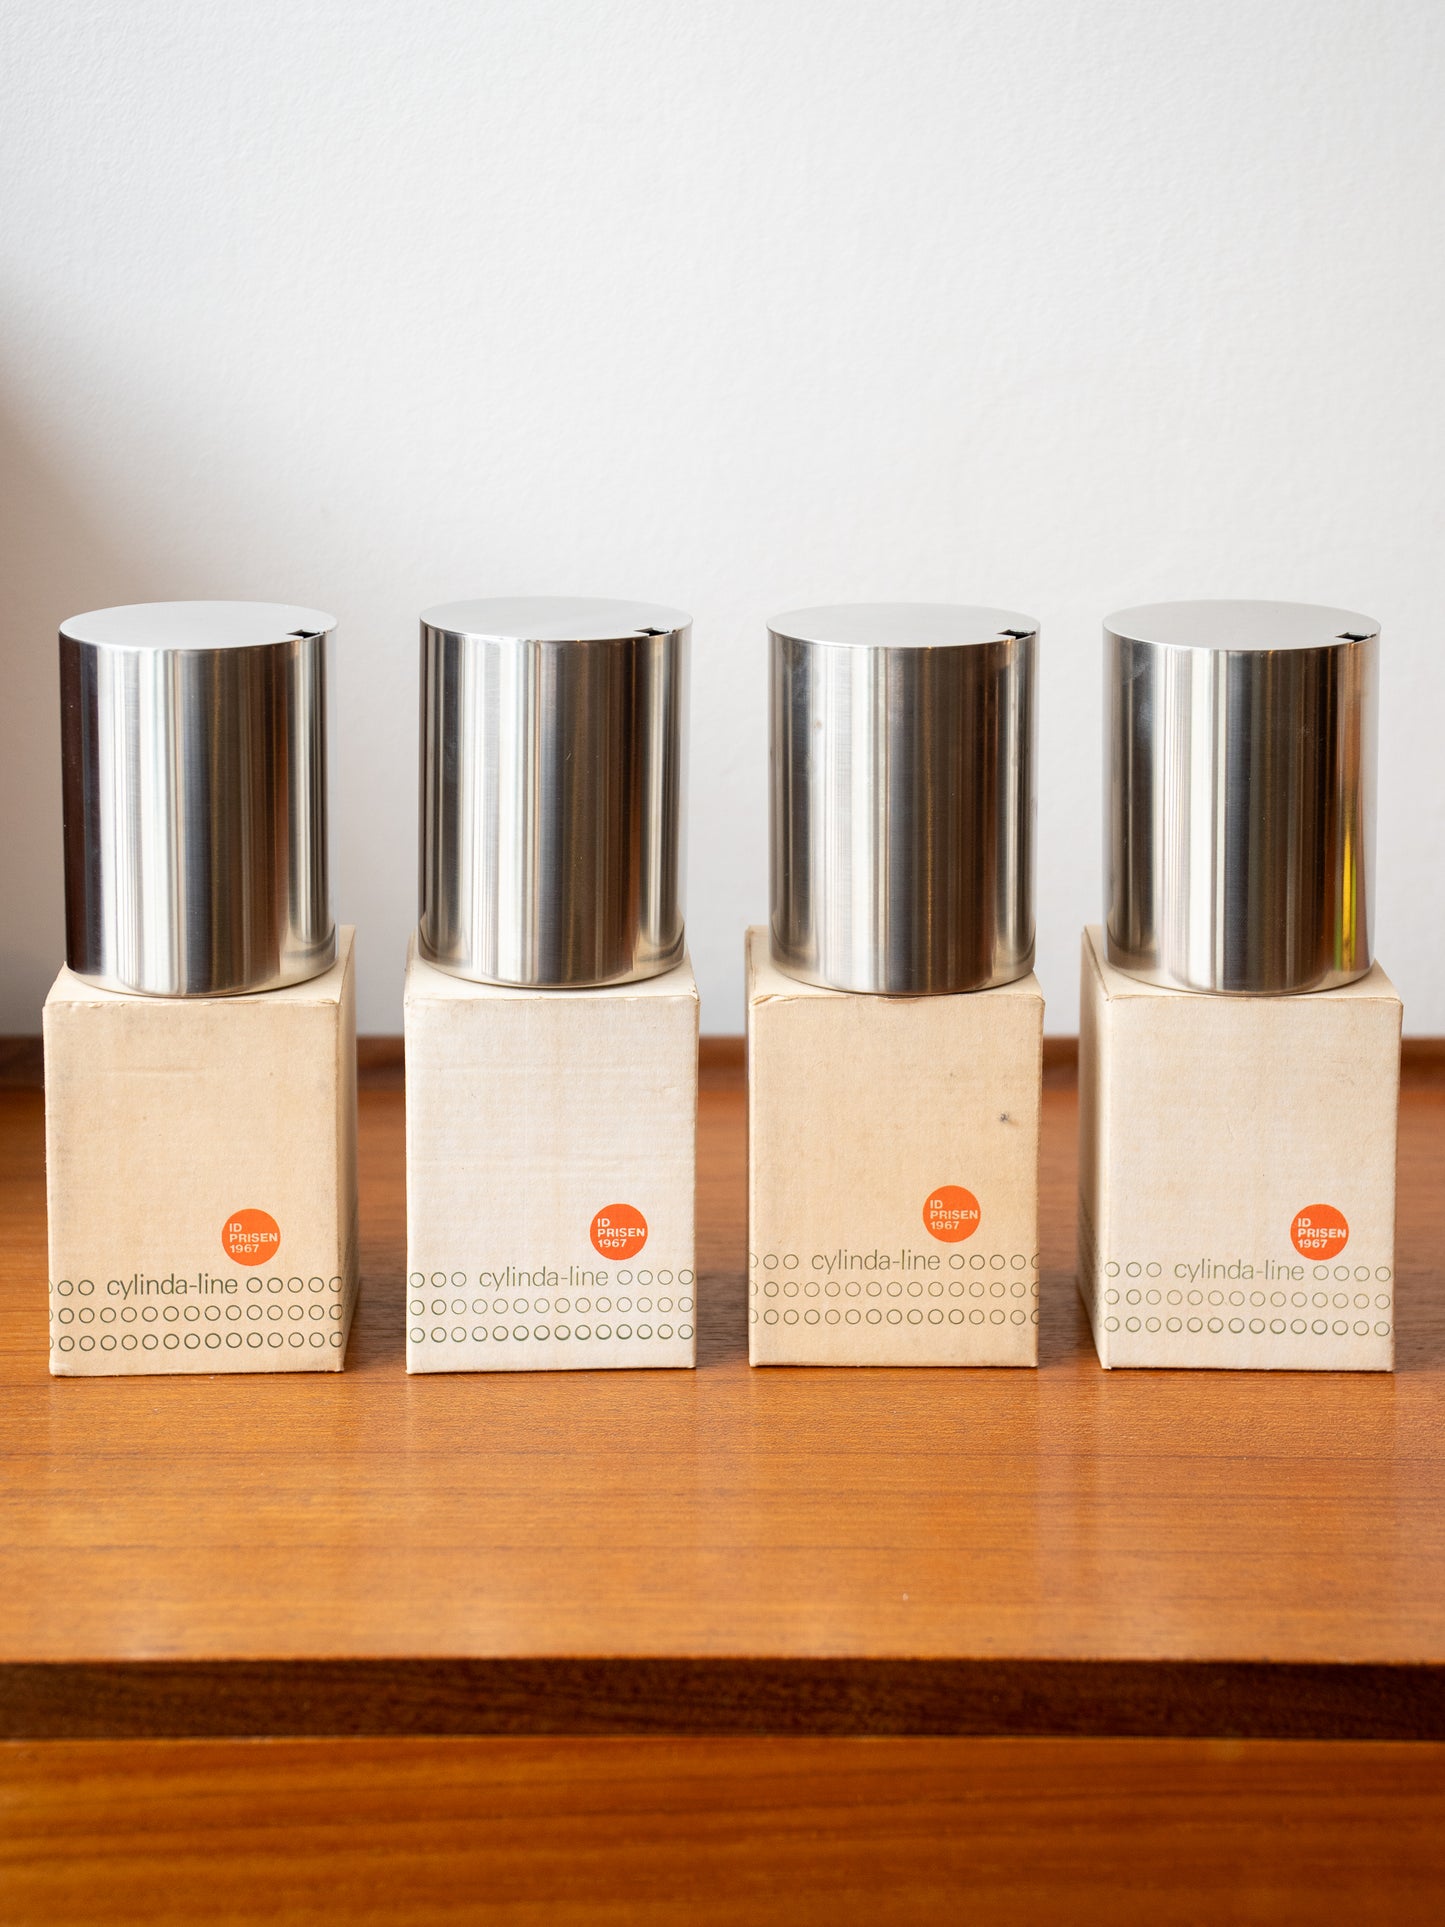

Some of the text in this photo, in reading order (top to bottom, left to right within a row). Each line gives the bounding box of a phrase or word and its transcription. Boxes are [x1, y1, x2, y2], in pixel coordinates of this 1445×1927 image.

[929, 1199, 943, 1209] ID
[929, 1209, 979, 1220] PRISEN
[597, 1217, 611, 1227] ID
[929, 1220, 960, 1230] 1967
[1297, 1217, 1311, 1228] ID
[229, 1223, 243, 1233] ID
[597, 1227, 645, 1238] PRISEN
[1297, 1228, 1347, 1239] PRISEN
[229, 1233, 279, 1243] PRISEN
[597, 1238, 627, 1248] 1967
[229, 1242, 260, 1253] 1967
[1297, 1239, 1328, 1249] 1967
[811, 1249, 941, 1274] cylinda-line
[1174, 1258, 1305, 1283] cylinda-line
[479, 1265, 609, 1291] cylinda-line
[106, 1273, 238, 1299] cylinda-line
